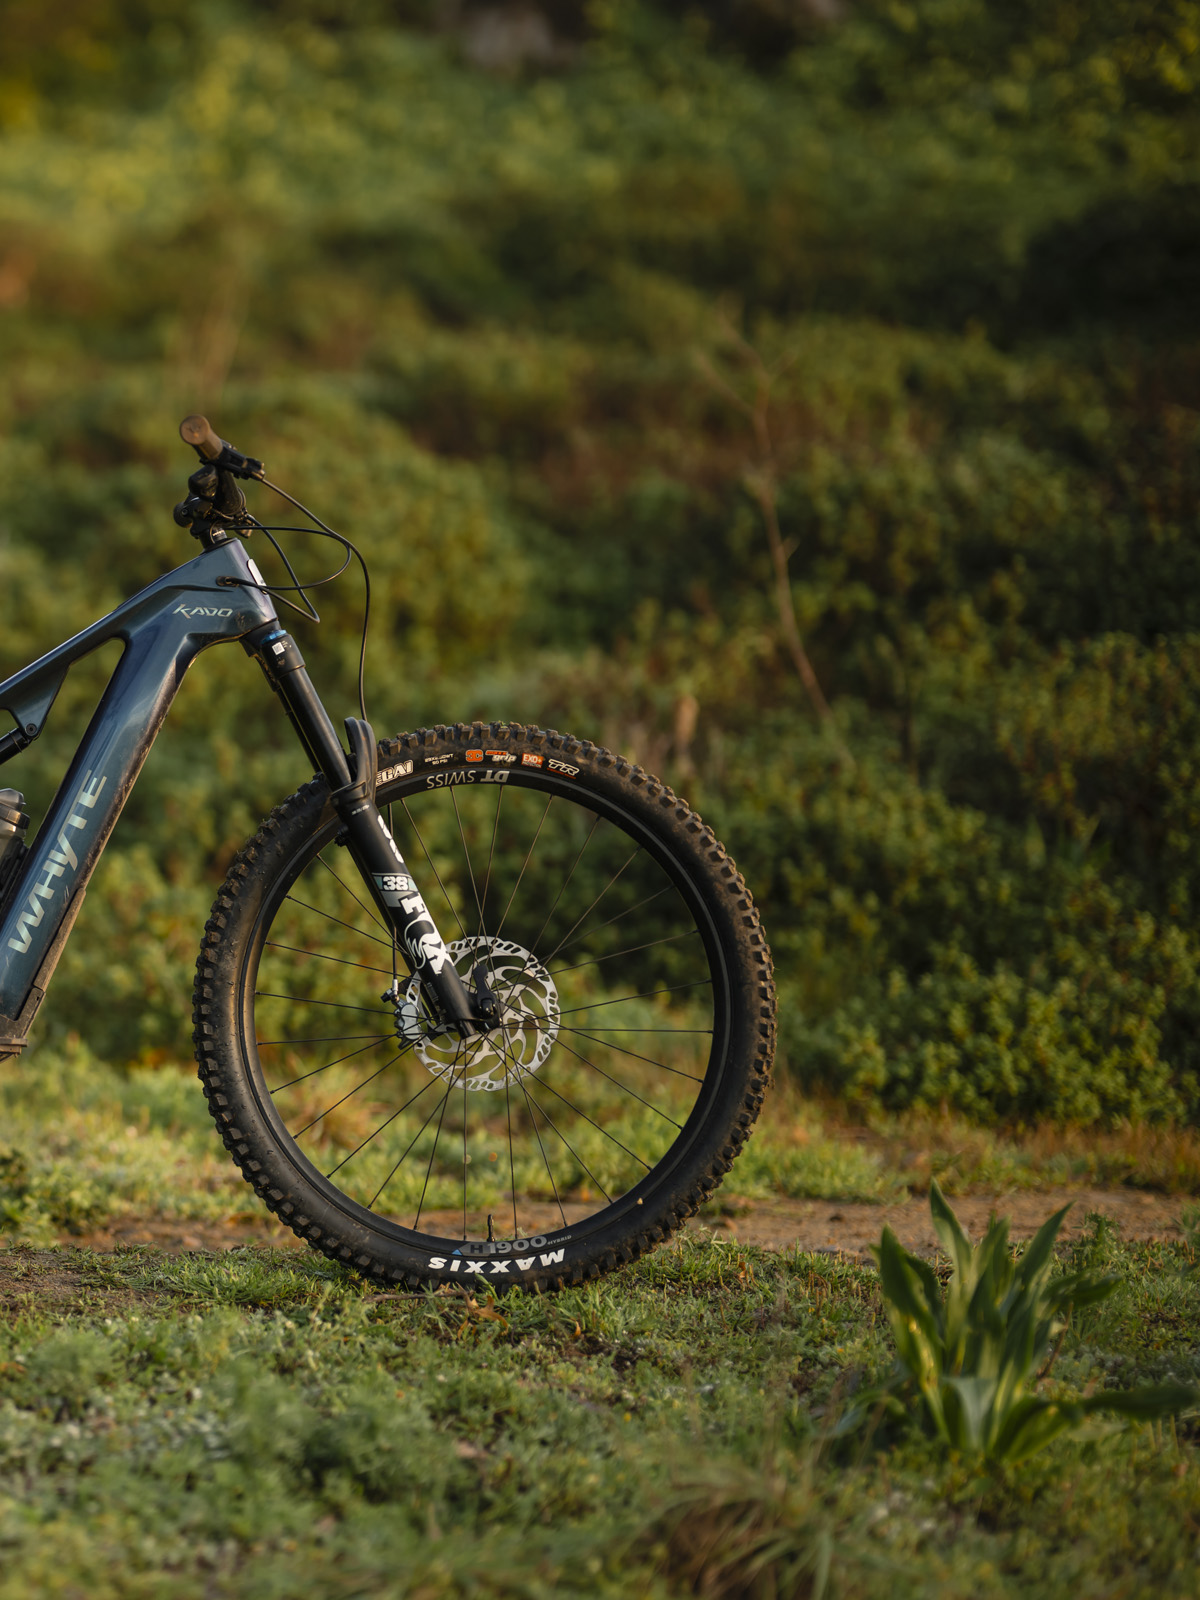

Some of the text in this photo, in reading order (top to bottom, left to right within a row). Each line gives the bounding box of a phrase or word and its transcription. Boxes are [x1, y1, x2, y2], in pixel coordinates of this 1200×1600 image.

[491, 752, 517, 763] grip
[522, 754, 542, 763] EXO+
[426, 770, 510, 789] DT SWISS
[7, 770, 107, 953] WHYTE
[382, 875, 409, 891] 38
[398, 891, 454, 975] FOX
[470, 1235, 548, 1254] H1900
[428, 1248, 565, 1274] MAXXIS
